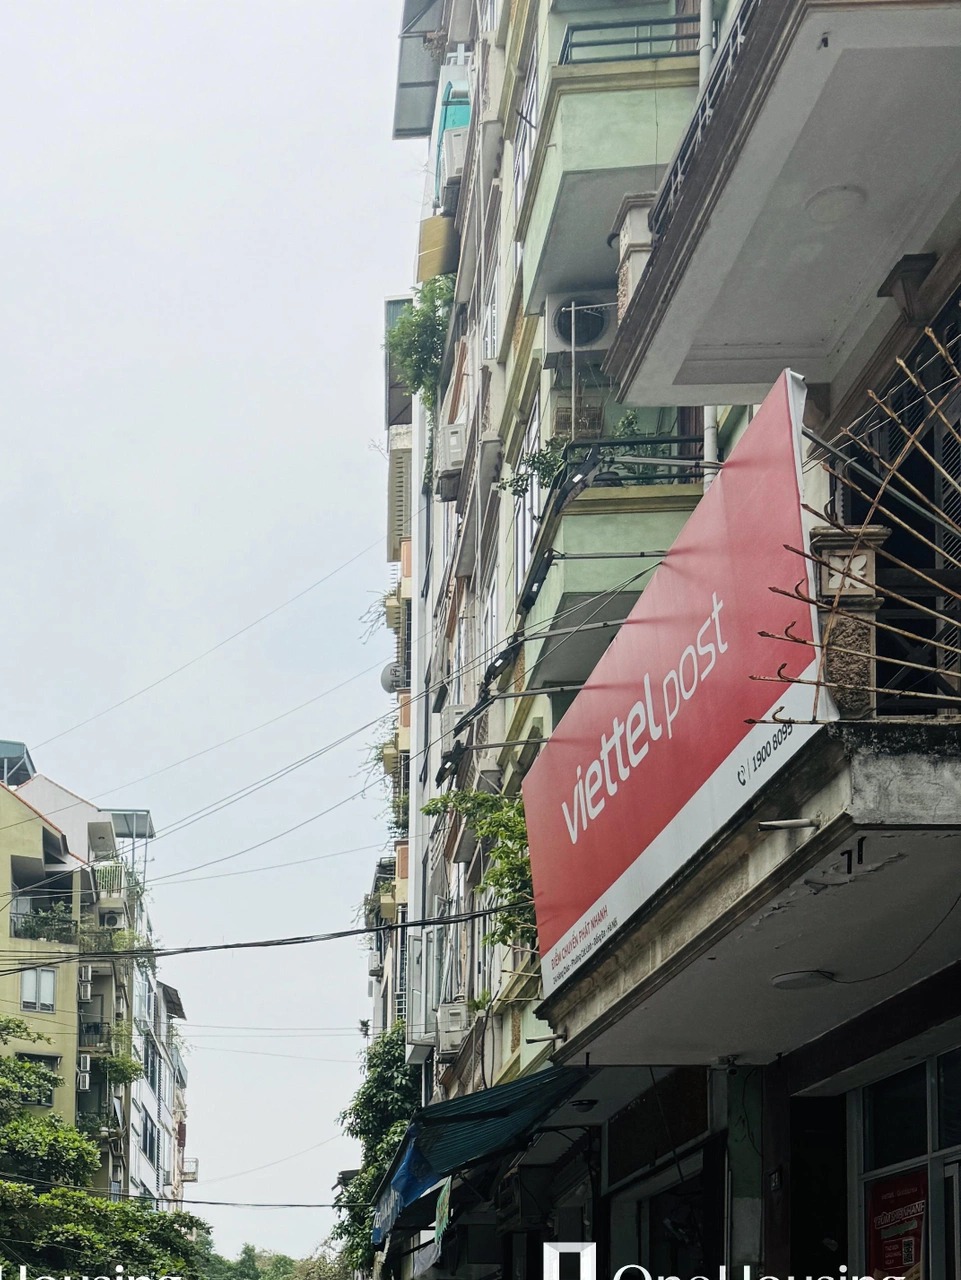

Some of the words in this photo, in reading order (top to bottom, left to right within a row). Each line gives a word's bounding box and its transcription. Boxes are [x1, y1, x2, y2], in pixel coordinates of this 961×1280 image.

[561, 672, 662, 845] viettel
[662, 591, 729, 740] post
[752, 740, 772, 773] 1900
[772, 722, 793, 751] 8095
